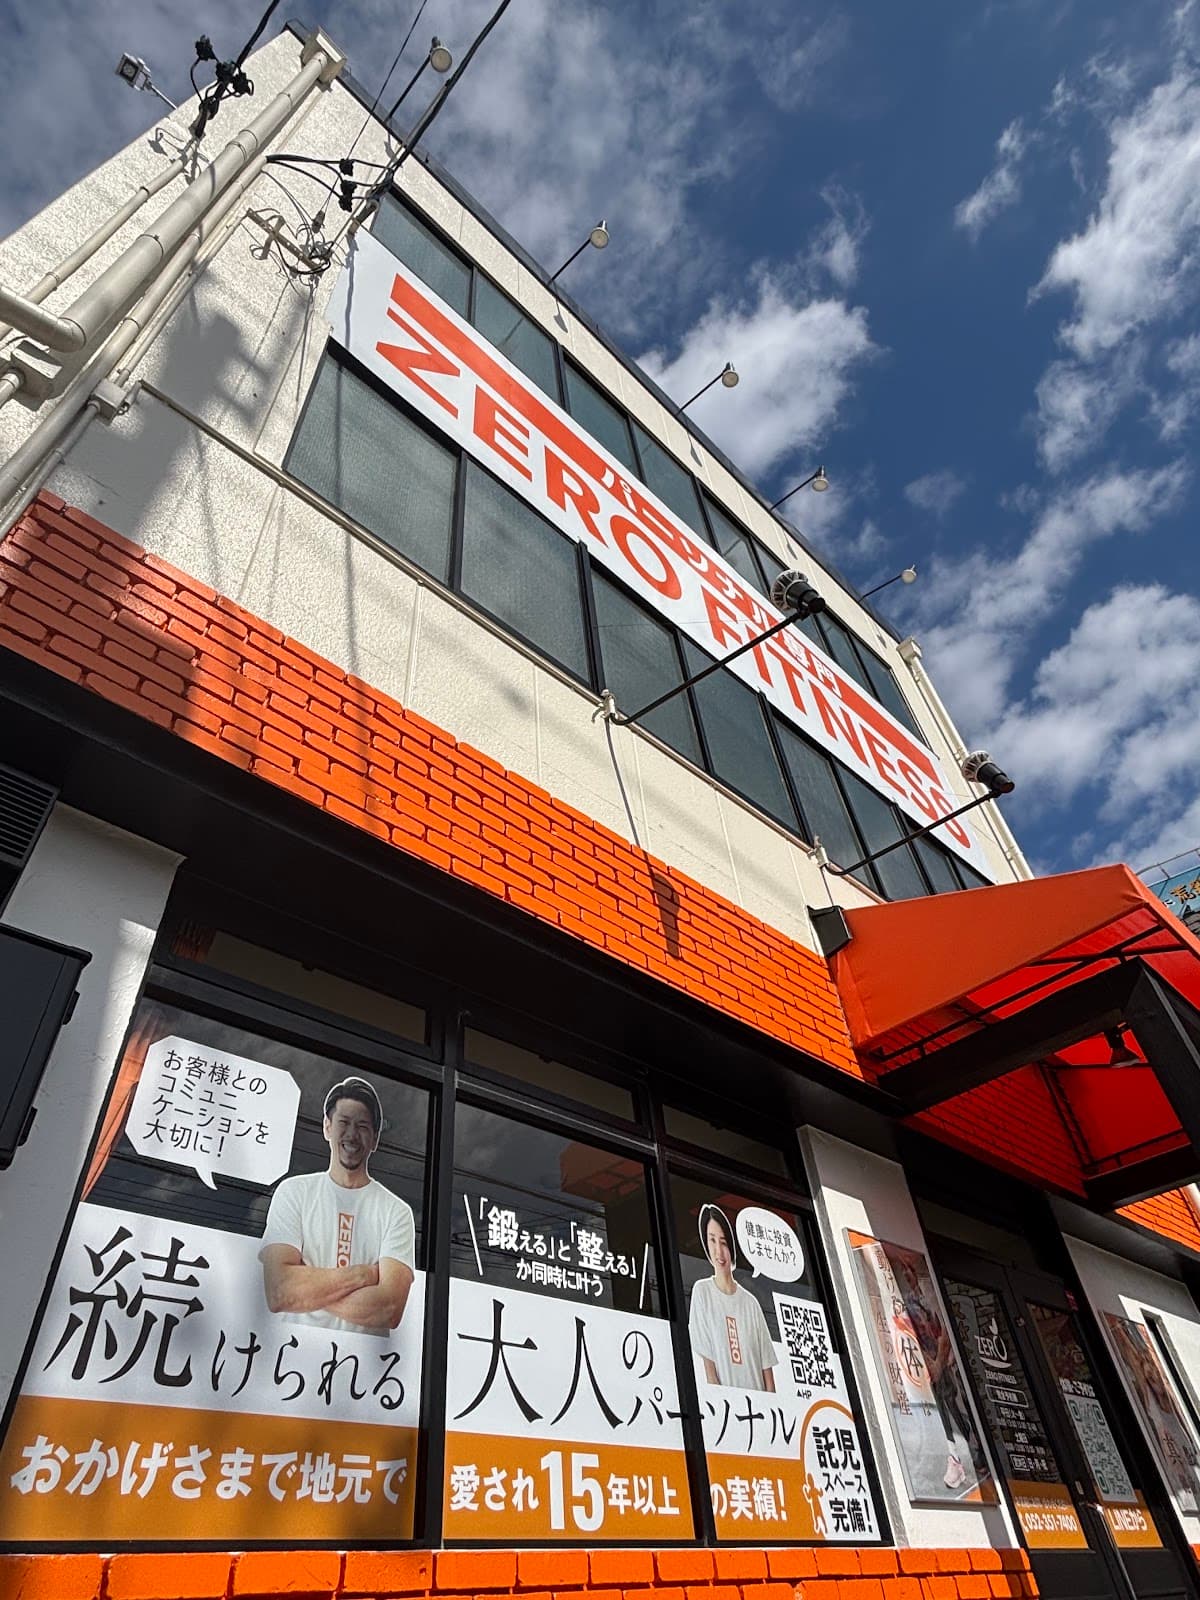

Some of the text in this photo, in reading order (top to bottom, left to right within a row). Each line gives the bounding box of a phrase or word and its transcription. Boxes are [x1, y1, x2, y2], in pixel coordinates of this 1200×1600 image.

[376, 306, 971, 849] ZERO FITNESS
[601, 467, 843, 699] パーソナル専門
[158, 1074, 237, 1110] コミュニ
[164, 1050, 267, 1095] お客様との
[152, 1094, 269, 1144] ケーションを
[338, 1213, 353, 1268] ZERO
[745, 1220, 793, 1248] 健康に投資
[44, 1226, 406, 1411] 続けられる
[727, 1318, 741, 1362] ZERO
[974, 1335, 1007, 1361] ZERO
[10, 1435, 408, 1504] おかげさまで地元で
[812, 1426, 860, 1471] 託児
[822, 1472, 866, 1494] スペース
